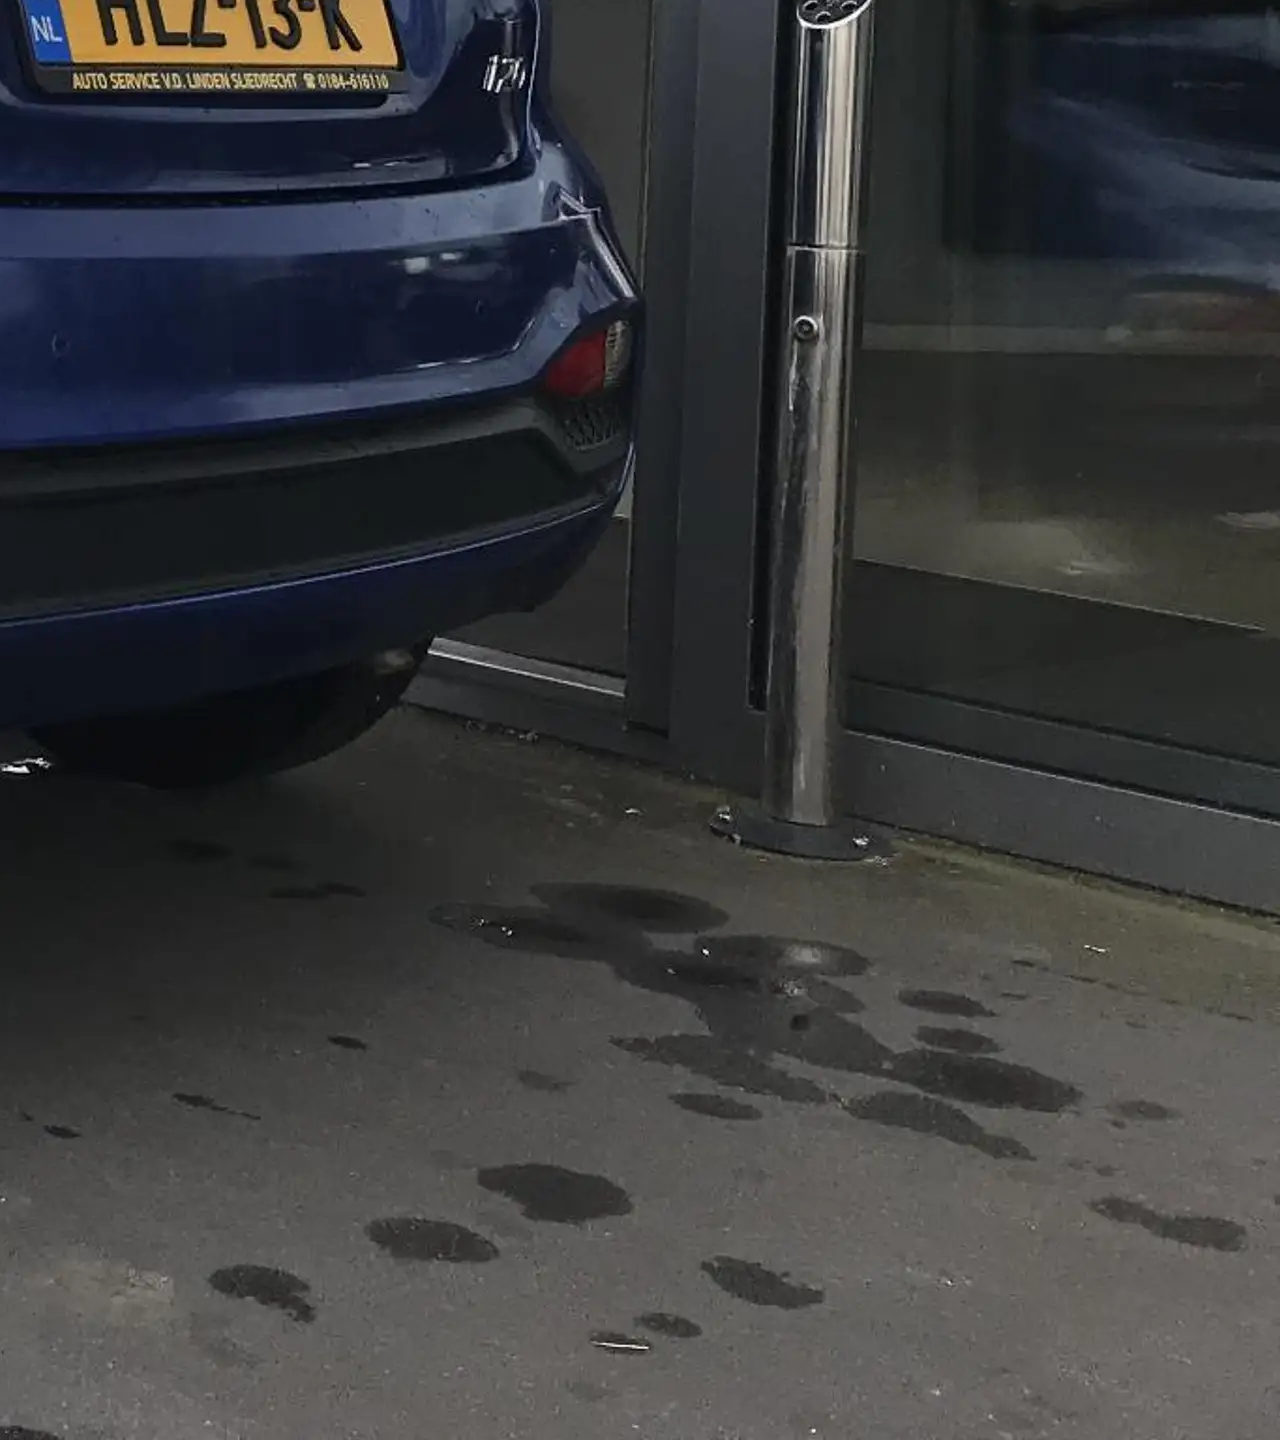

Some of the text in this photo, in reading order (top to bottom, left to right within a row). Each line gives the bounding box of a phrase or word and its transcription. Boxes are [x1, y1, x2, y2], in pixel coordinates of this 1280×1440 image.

[30, 15, 64, 43] NL
[73, 72, 108, 90] AUTO
[110, 72, 160, 90] SERVICE
[187, 72, 231, 90] LINDEN
[232, 72, 297, 91] SLIEDRECHT
